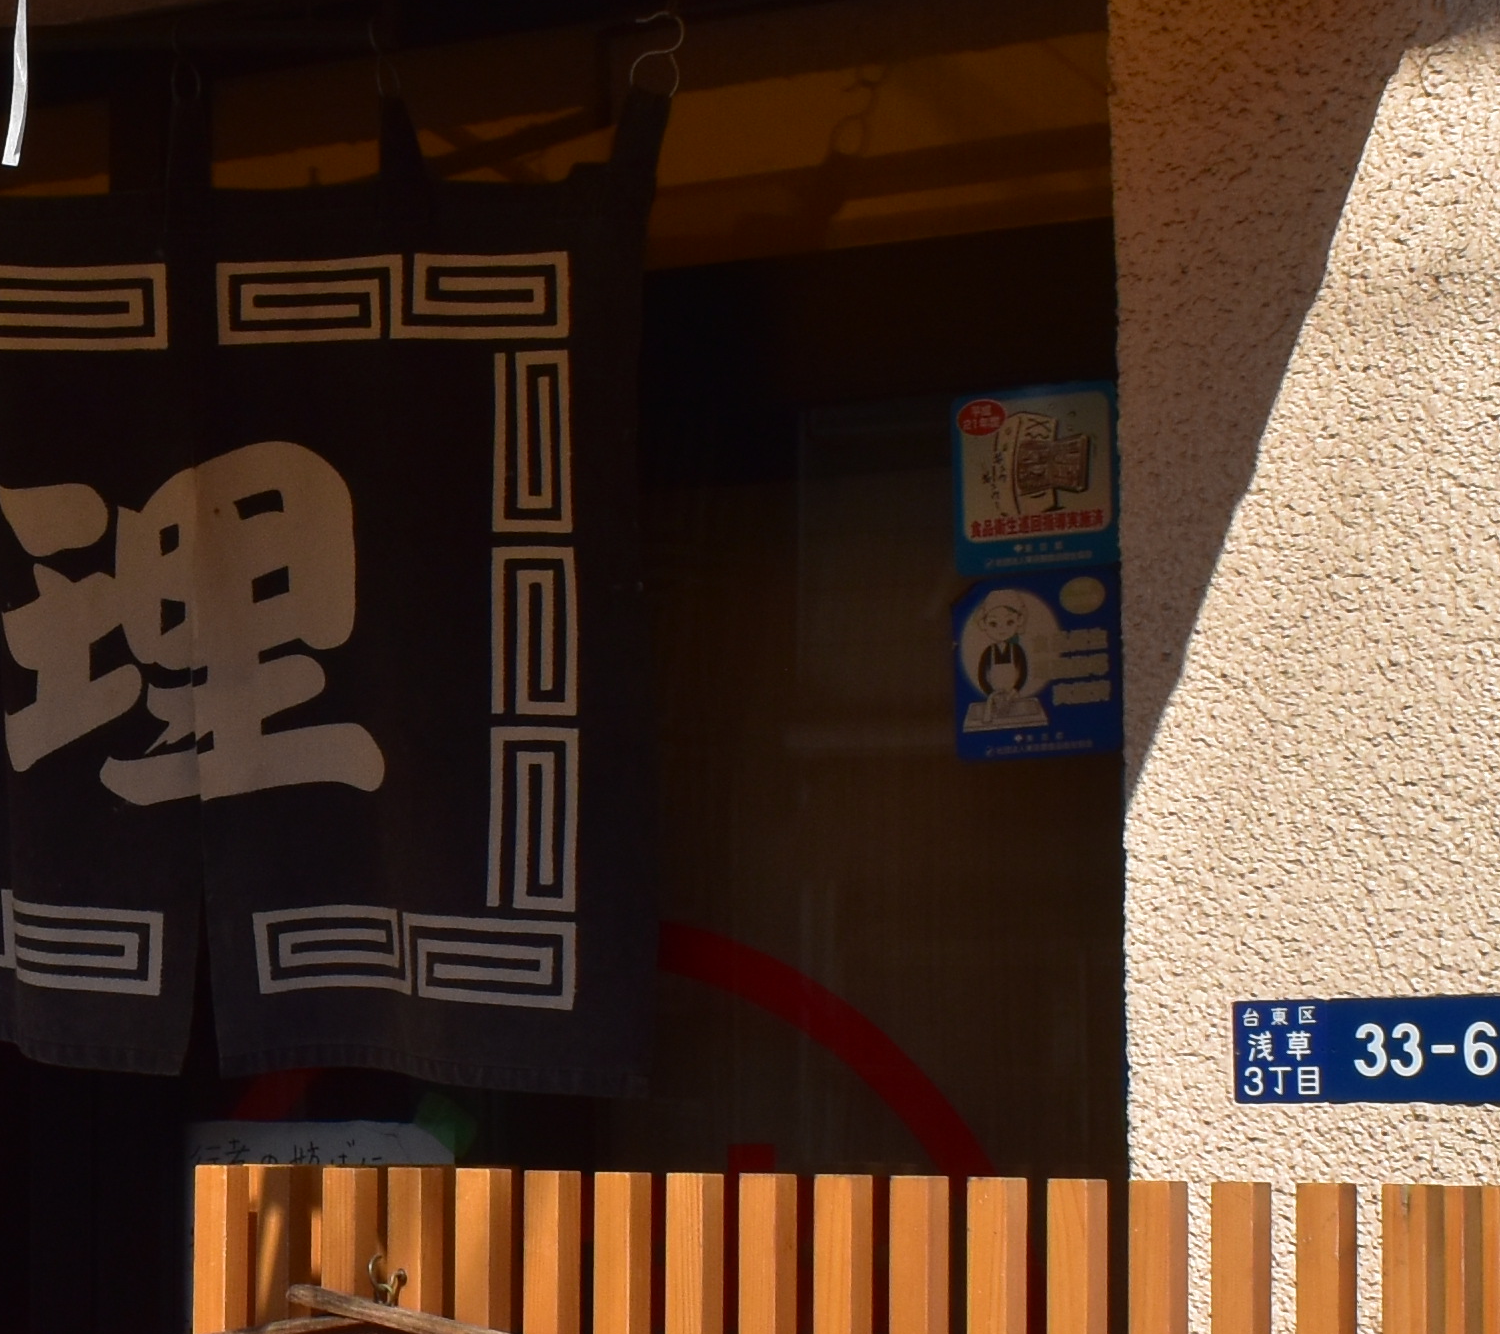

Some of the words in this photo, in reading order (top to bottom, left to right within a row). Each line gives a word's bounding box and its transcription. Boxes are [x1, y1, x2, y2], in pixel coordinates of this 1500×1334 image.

[1242, 1005, 1316, 1027] 台東区
[1353, 1021, 1498, 1077] 33-6
[1248, 1030, 1311, 1061] 浅草
[1244, 1066, 1320, 1096] 3丁目
